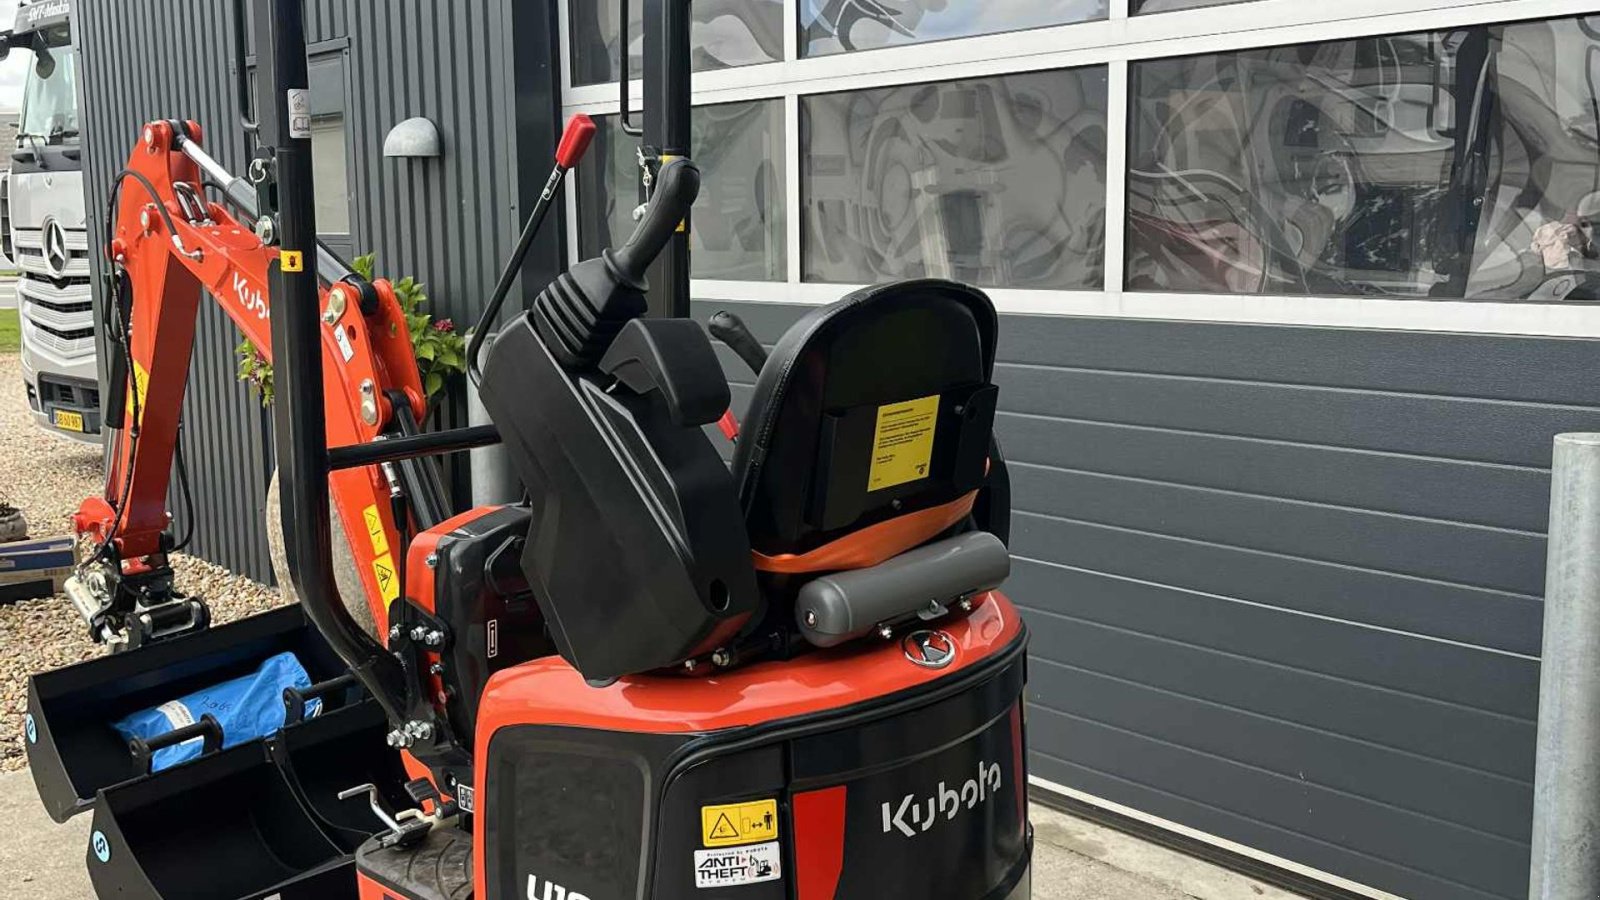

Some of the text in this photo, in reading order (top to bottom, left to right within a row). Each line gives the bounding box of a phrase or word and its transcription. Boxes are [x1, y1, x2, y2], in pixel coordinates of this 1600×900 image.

[233, 271, 270, 319] Kub
[881, 760, 1002, 838] Kubota
[698, 866, 748, 879] THEFT
[699, 856, 740, 868] ANTI
